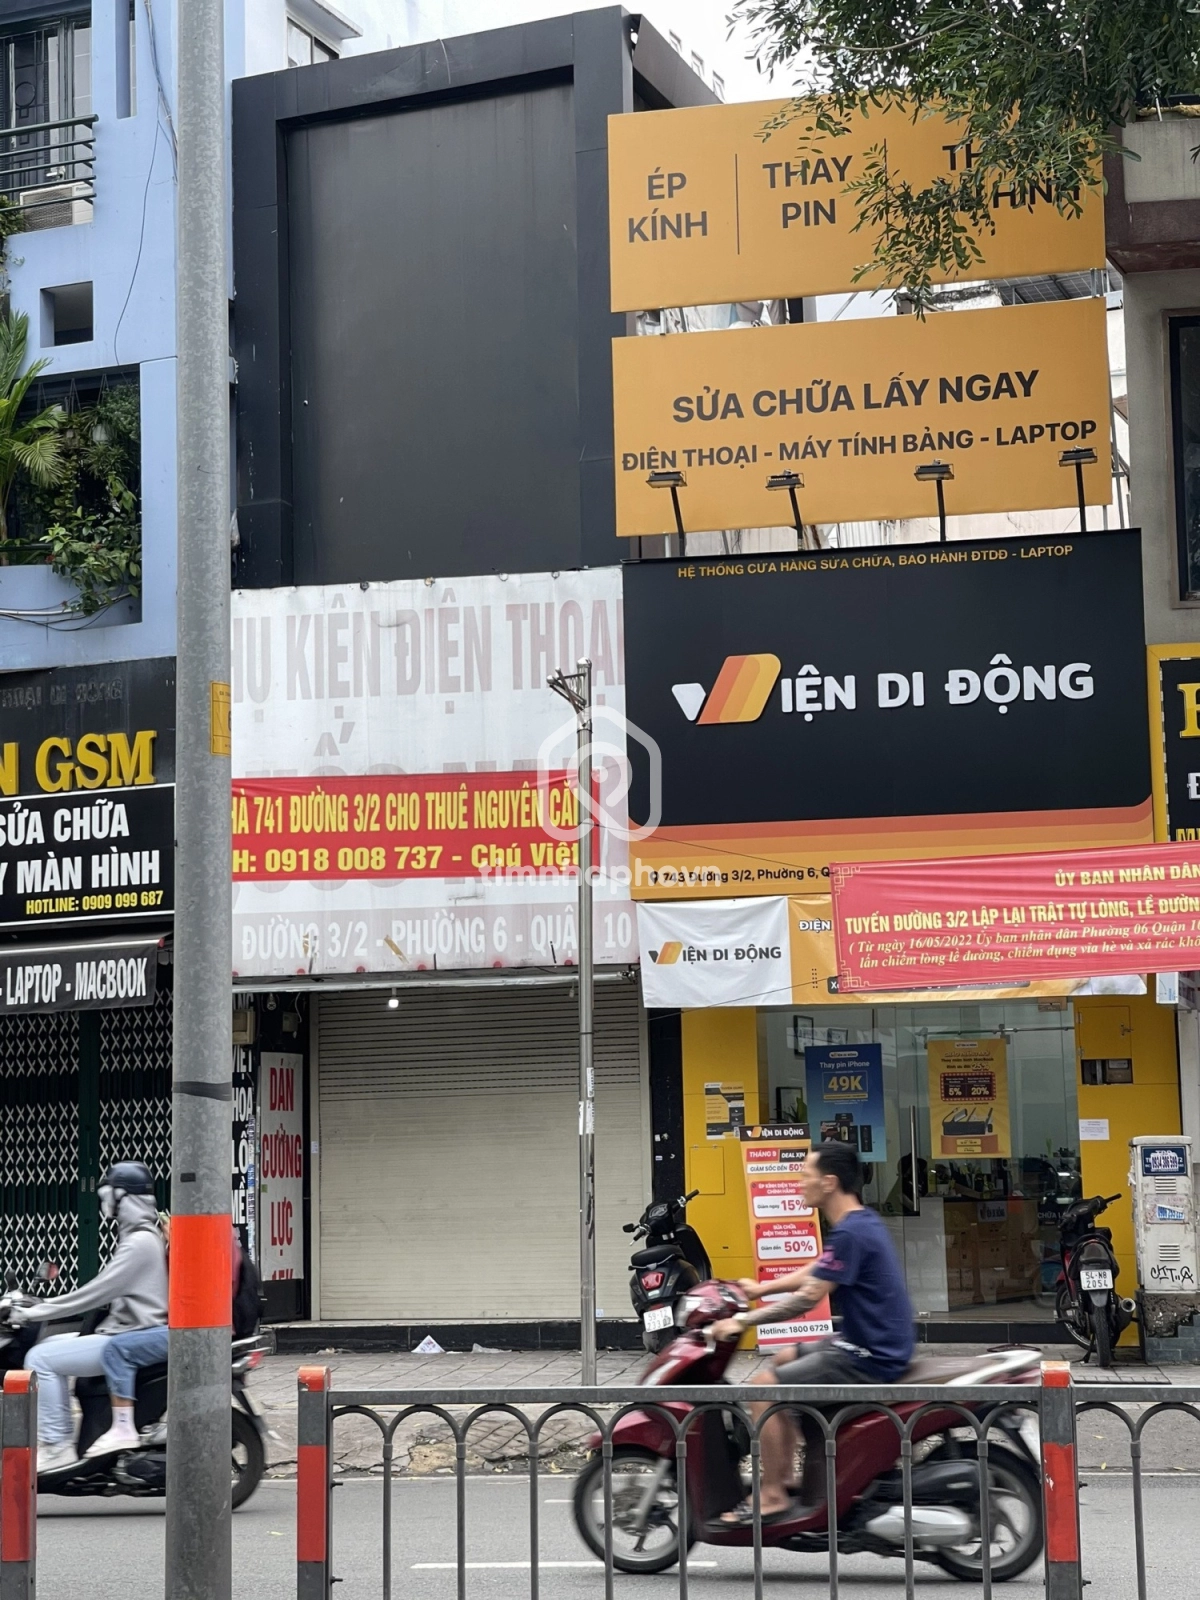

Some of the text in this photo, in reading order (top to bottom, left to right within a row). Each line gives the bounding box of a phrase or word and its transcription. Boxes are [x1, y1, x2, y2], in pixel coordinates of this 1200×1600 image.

[648, 167, 687, 200] ÉP
[762, 156, 853, 189] THAY
[628, 208, 708, 243] KÍNH
[782, 199, 836, 229] PIN
[672, 370, 1039, 423] SỬA CHỮA LẤY NGAY
[682, 444, 757, 469] THOẠI
[779, 434, 832, 461] MÁY
[841, 431, 897, 456] TÍNH
[903, 426, 974, 453] BẢNG
[996, 420, 1097, 446] LAPTOP
[678, 565, 696, 579] HỆ
[699, 562, 744, 577] THỐNG
[780, 559, 817, 572] HÀNG
[930, 550, 968, 564] HÀNH
[971, 548, 1008, 562] ĐTDĐ
[1020, 544, 1073, 559] LAPTOP
[231, 617, 272, 723] HỤ
[286, 593, 381, 719] KIỆN
[394, 587, 492, 714] ĐIỆN
[877, 671, 925, 709] DI
[944, 652, 1095, 715] ĐỘNG
[35, 730, 157, 793] GSM
[53, 798, 130, 843] CHỮA
[254, 797, 282, 834] 741
[290, 785, 349, 833] ĐƯỜNG
[354, 793, 380, 832] 3/2
[386, 792, 420, 831] CHO
[425, 783, 468, 830] THUÊ
[474, 781, 544, 829] NGUYÊN
[17, 846, 160, 894] MÀN HÌNH
[265, 848, 329, 873] 0918
[338, 847, 386, 871] 008
[394, 845, 443, 869] 737
[471, 842, 521, 869] Chú
[731, 869, 755, 882] 3/2,
[757, 868, 804, 883] Phường
[807, 868, 819, 880] 6,
[1054, 862, 1200, 887] ỦY BAN NHÂN DÂN
[26, 890, 164, 915] HOTLINE: 0909 099 687
[845, 911, 890, 934] TUYẾN
[893, 909, 942, 931] ĐƯỜNG
[946, 910, 969, 928] 3/2
[972, 905, 999, 930] LẬP
[1003, 906, 1026, 927] LẠI
[1029, 902, 1064, 925] TRẬT
[1068, 901, 1088, 923] TỰ
[1091, 899, 1134, 918] LÒNG,
[1137, 894, 1155, 915] LỀ
[241, 914, 319, 960] ĐƯỜNG
[328, 922, 368, 957] 3/2
[392, 908, 486, 956] PHƯỜNG
[493, 917, 507, 952] 6
[531, 904, 577, 957] QUẬ
[604, 912, 632, 948] 10
[799, 919, 831, 934] ĐIỆN
[858, 920, 1185, 953] Từ ngày 16/05/2022 Ủy ban nhân dân Phường 06 Quận
[713, 949, 728, 961] DI
[734, 944, 782, 963] ĐỘNG
[881, 950, 916, 966] chiếm
[920, 952, 946, 966] lòng
[962, 948, 1004, 962] đường,
[1008, 943, 1043, 959] chiếm
[1046, 944, 1077, 959] dụng
[1102, 941, 1117, 953] hè
[1120, 939, 1134, 951] và
[1155, 938, 1174, 949] rác
[7, 957, 147, 1006] LAPTOP MACBOOK
[836, 1061, 847, 1069] pin
[848, 1060, 870, 1068] iPhone
[269, 1058, 294, 1112] DÁN
[828, 1075, 863, 1091] 49K
[783, 1127, 804, 1137] ĐỘNG
[262, 1123, 302, 1179] CƯỜNG
[781, 1199, 808, 1211] 15%
[271, 1197, 293, 1257] LỰC
[784, 1240, 813, 1252] 50%
[760, 1324, 829, 1335] Hotline: 1800 6729
